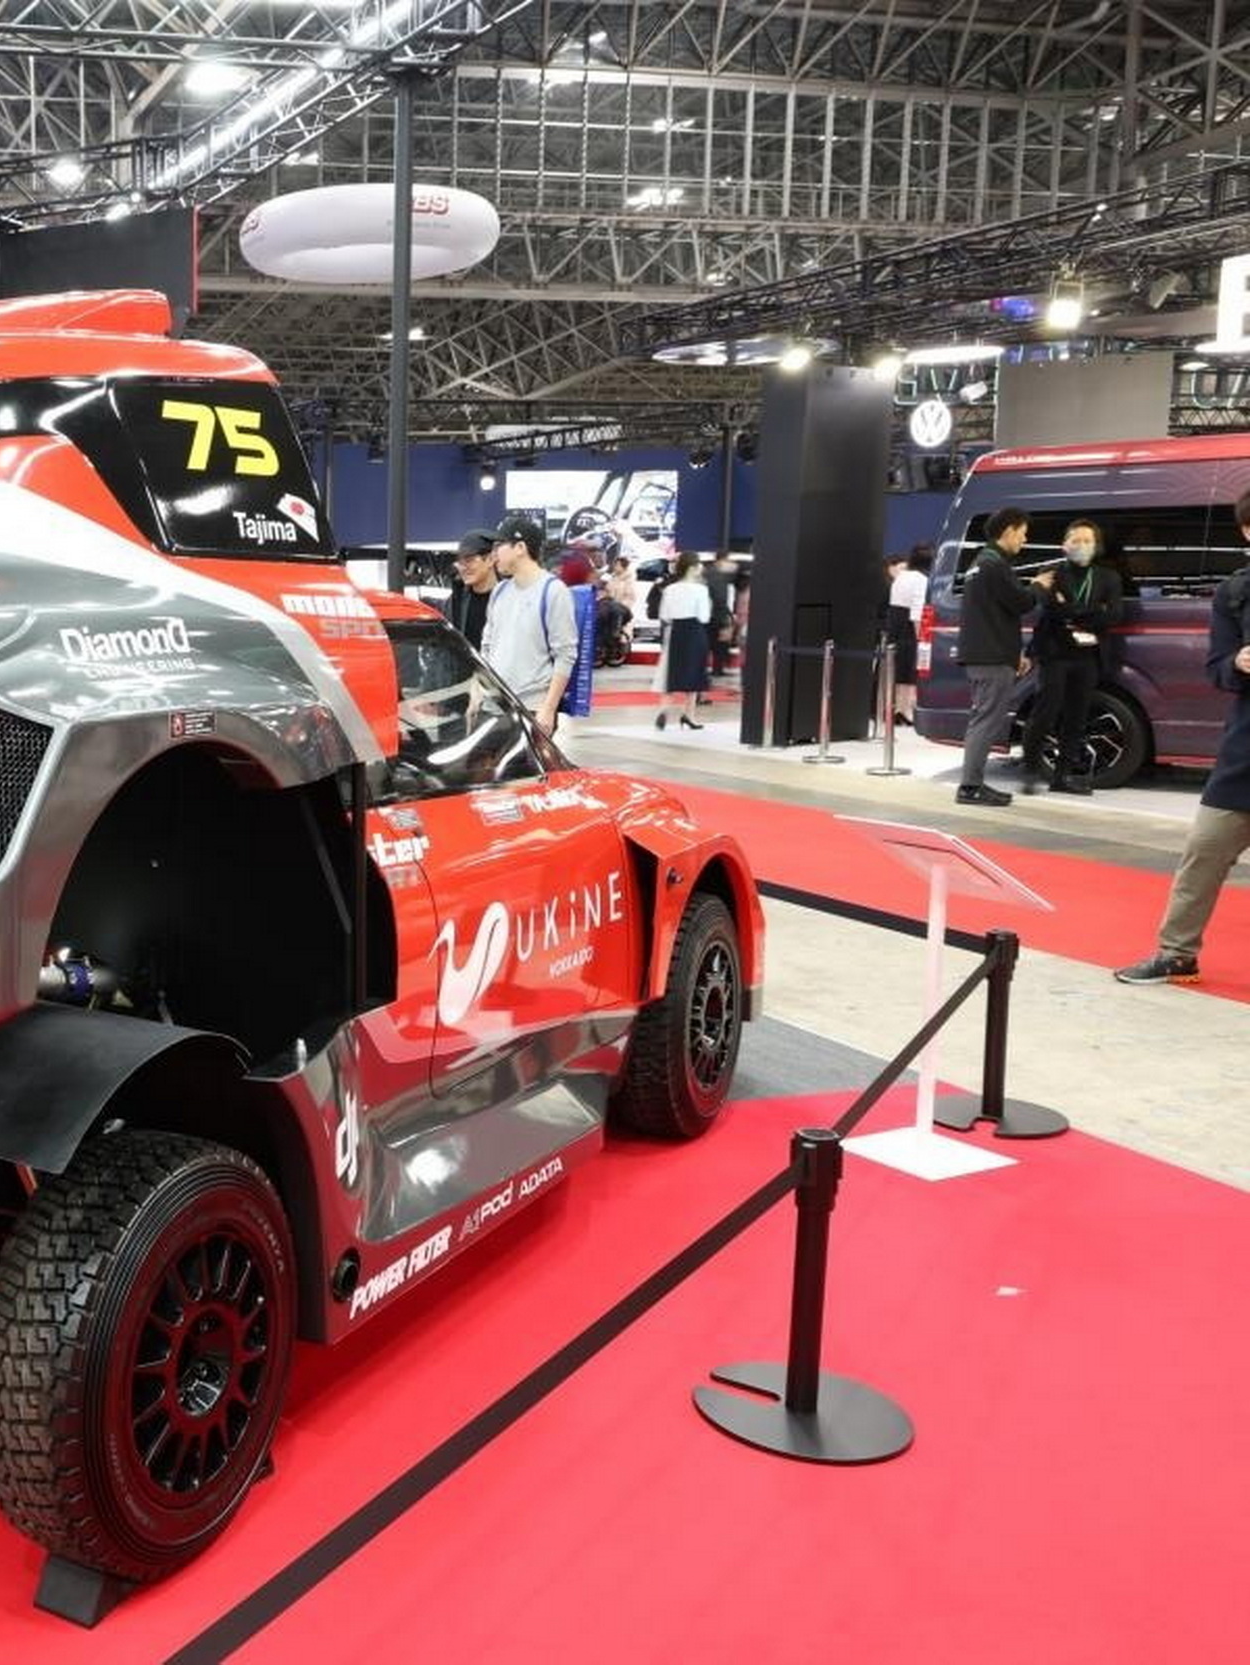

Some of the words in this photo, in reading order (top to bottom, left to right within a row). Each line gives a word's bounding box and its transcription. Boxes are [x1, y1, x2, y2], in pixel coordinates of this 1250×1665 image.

[410, 193, 449, 216] BS
[162, 400, 279, 476] 75
[233, 511, 298, 544] Tajima
[367, 833, 430, 867] ter
[350, 1255, 407, 1319] POWER
